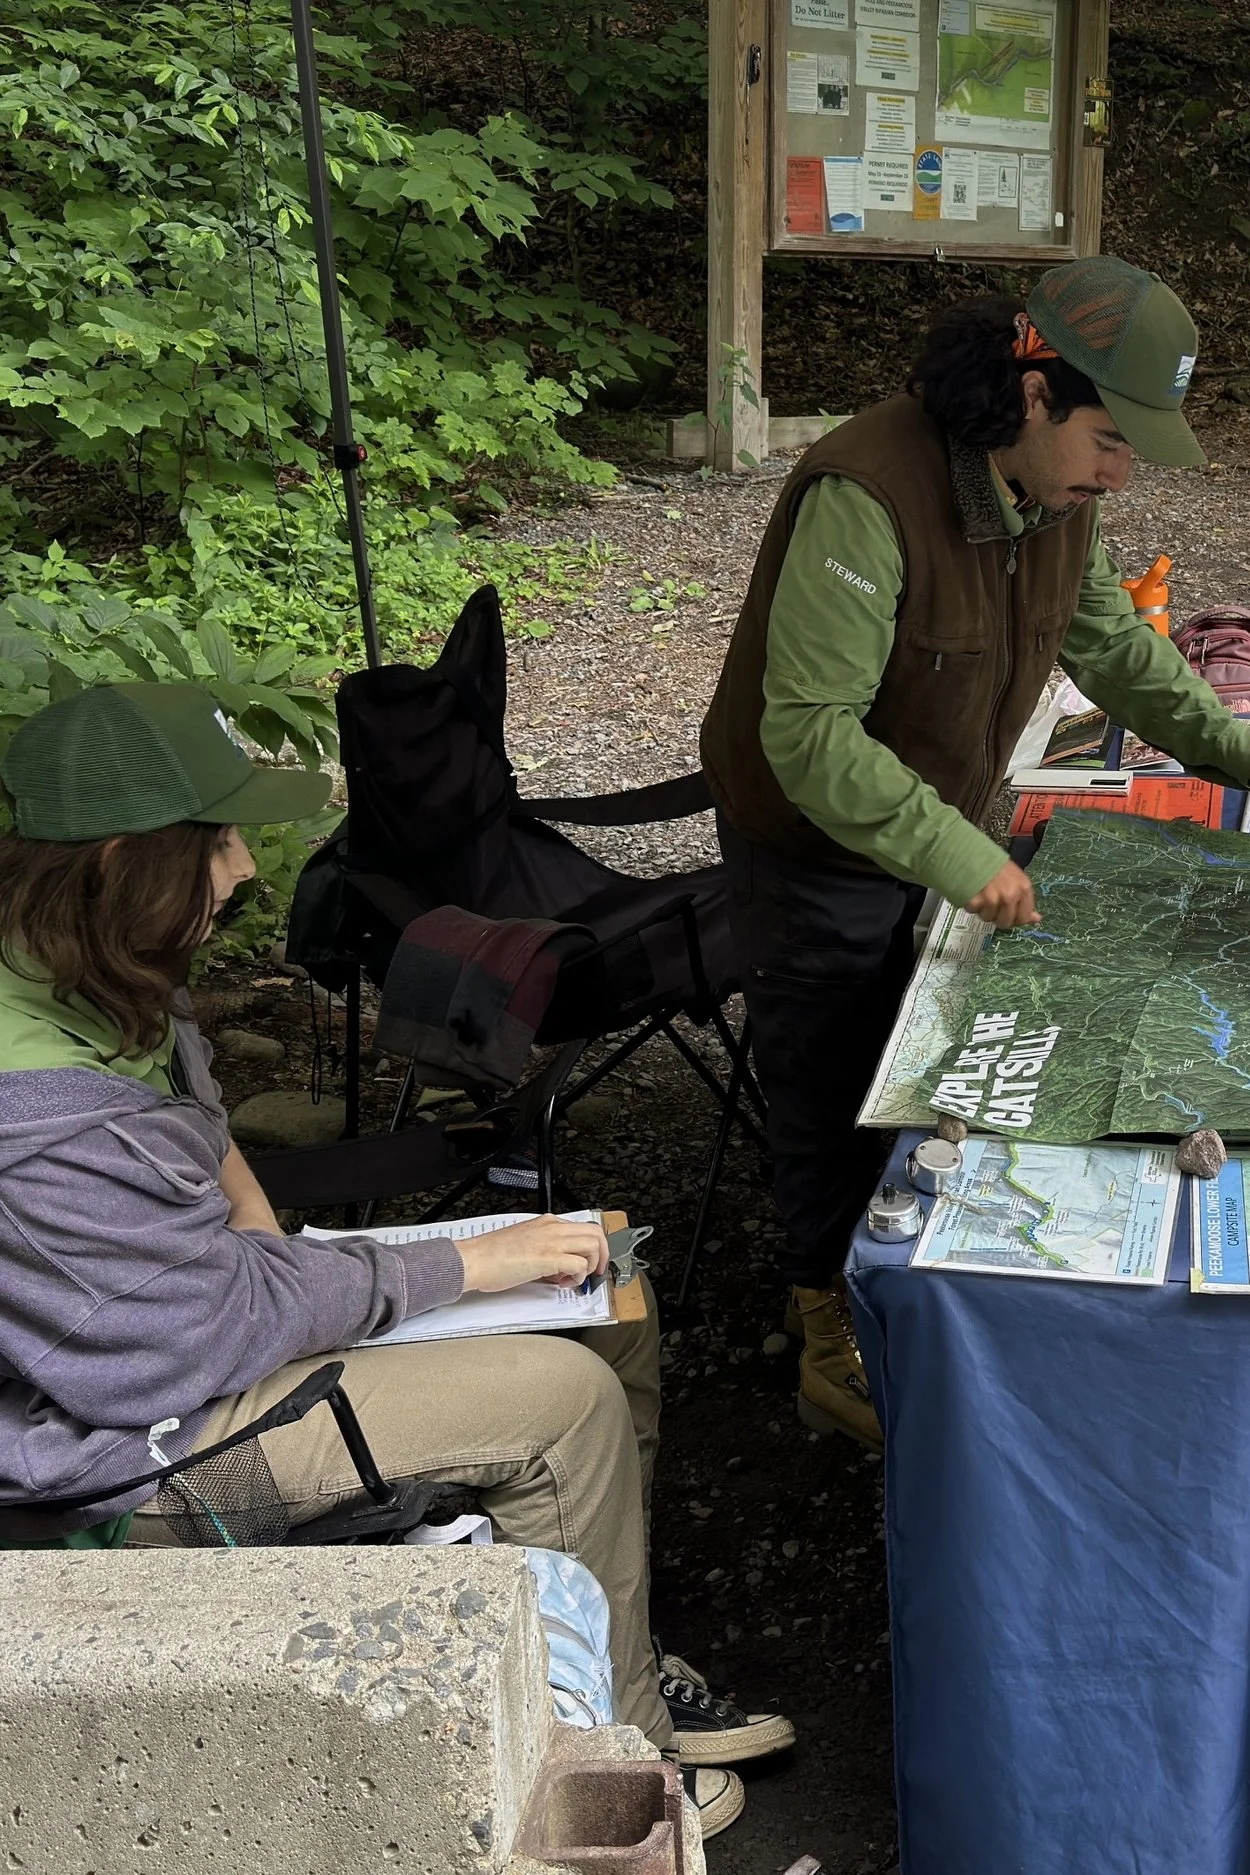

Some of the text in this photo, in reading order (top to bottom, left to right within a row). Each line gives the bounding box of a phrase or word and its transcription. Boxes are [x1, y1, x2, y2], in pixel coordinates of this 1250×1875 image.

[795, 6, 845, 19] Do Not Litter
[825, 557, 877, 594] STEWARD
[1030, 794, 1049, 819] ATTENTIO
[929, 1011, 1020, 1118] EXPLRE HE
[1207, 1189, 1220, 1218] LOWER
[1225, 1197, 1239, 1246] CAMPSITE MAP
[1208, 1219, 1223, 1277] PEEKAMOOSE
